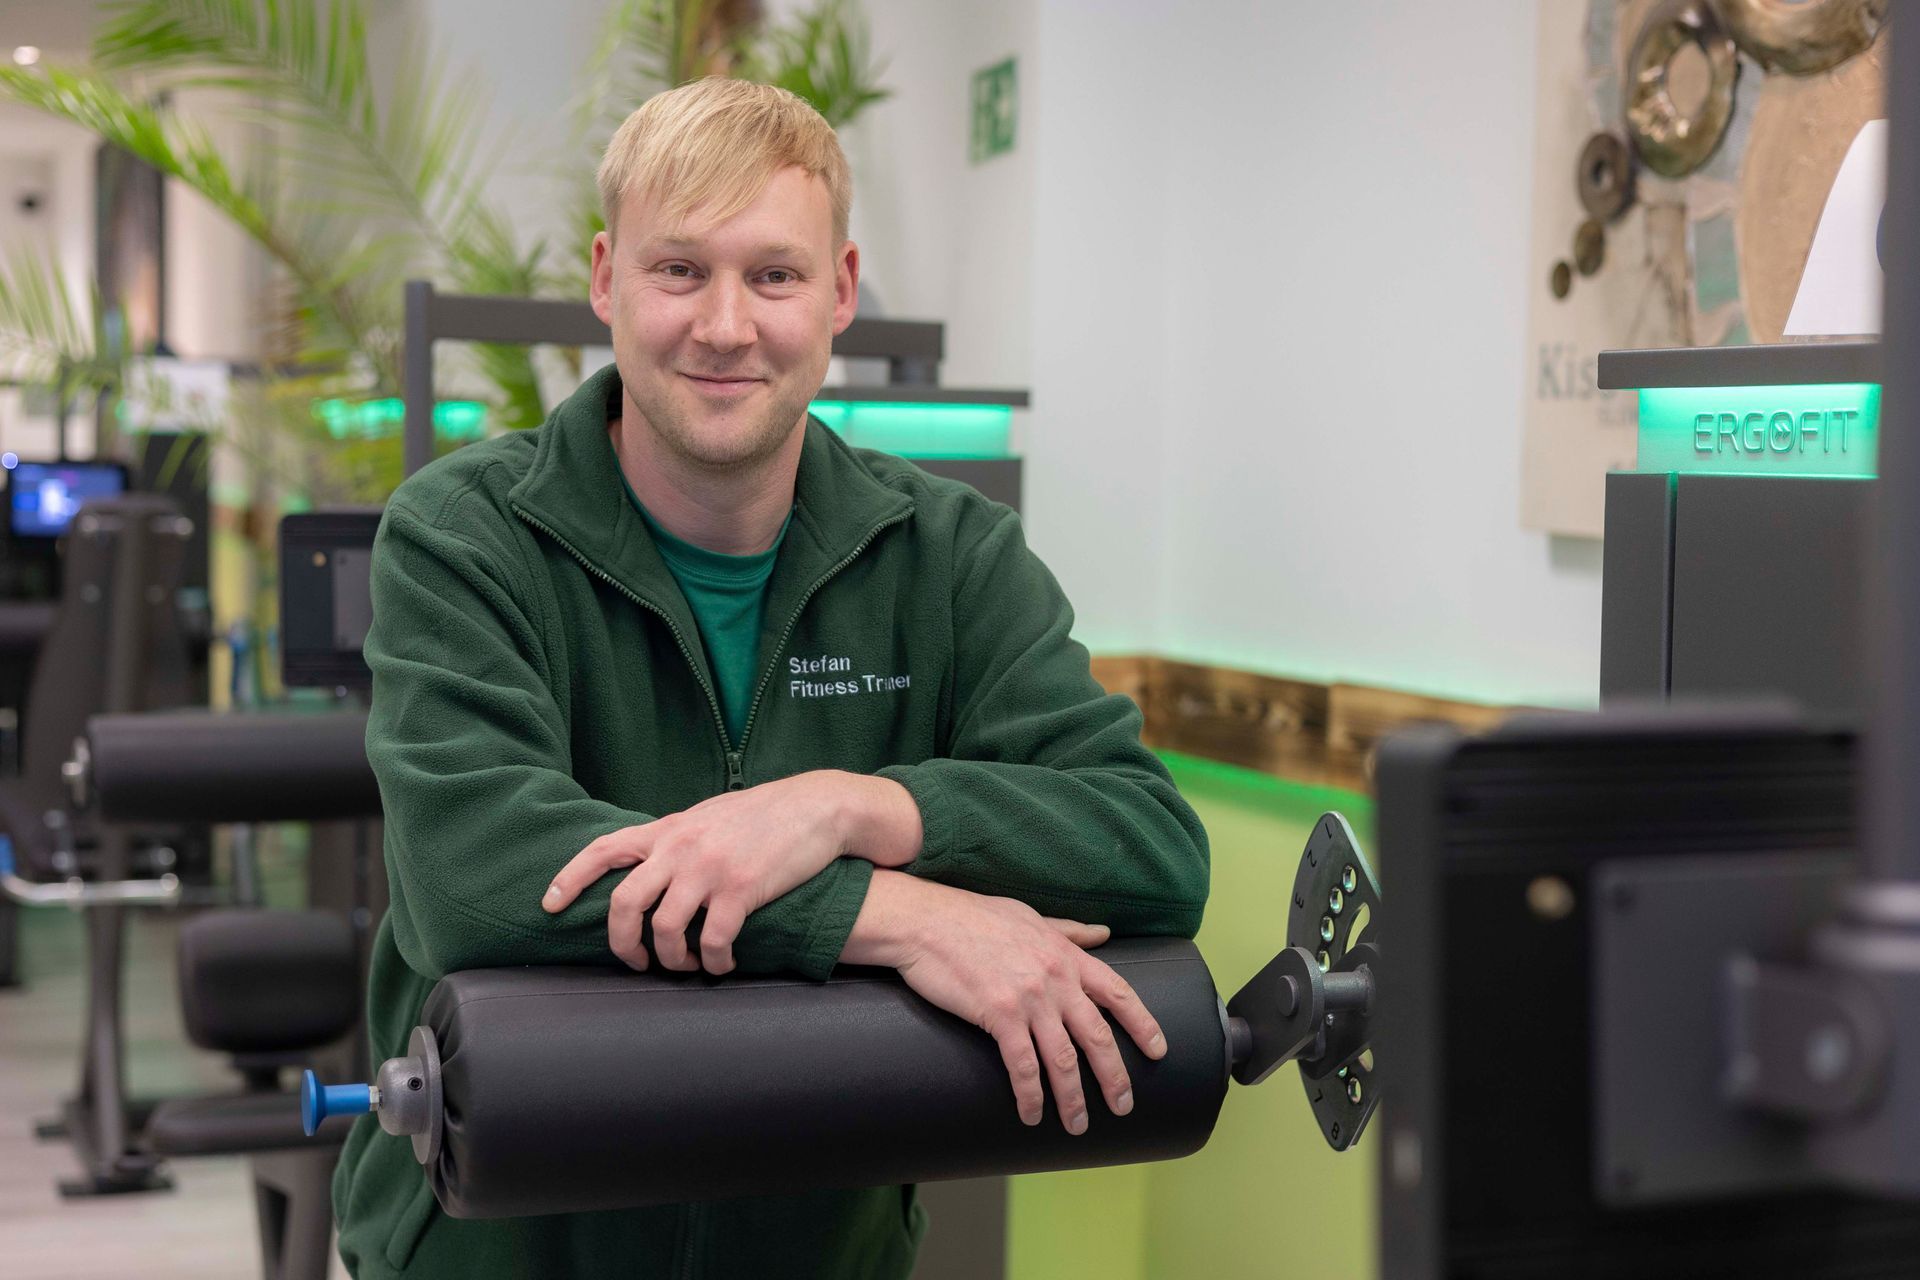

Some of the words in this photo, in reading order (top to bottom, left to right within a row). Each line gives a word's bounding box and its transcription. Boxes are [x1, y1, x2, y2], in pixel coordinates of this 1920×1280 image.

[1693, 408, 1858, 453] ERGOFIT
[789, 655, 850, 674] Stefan
[790, 680, 859, 698] Fitness
[1330, 1121, 1341, 1141] 8
